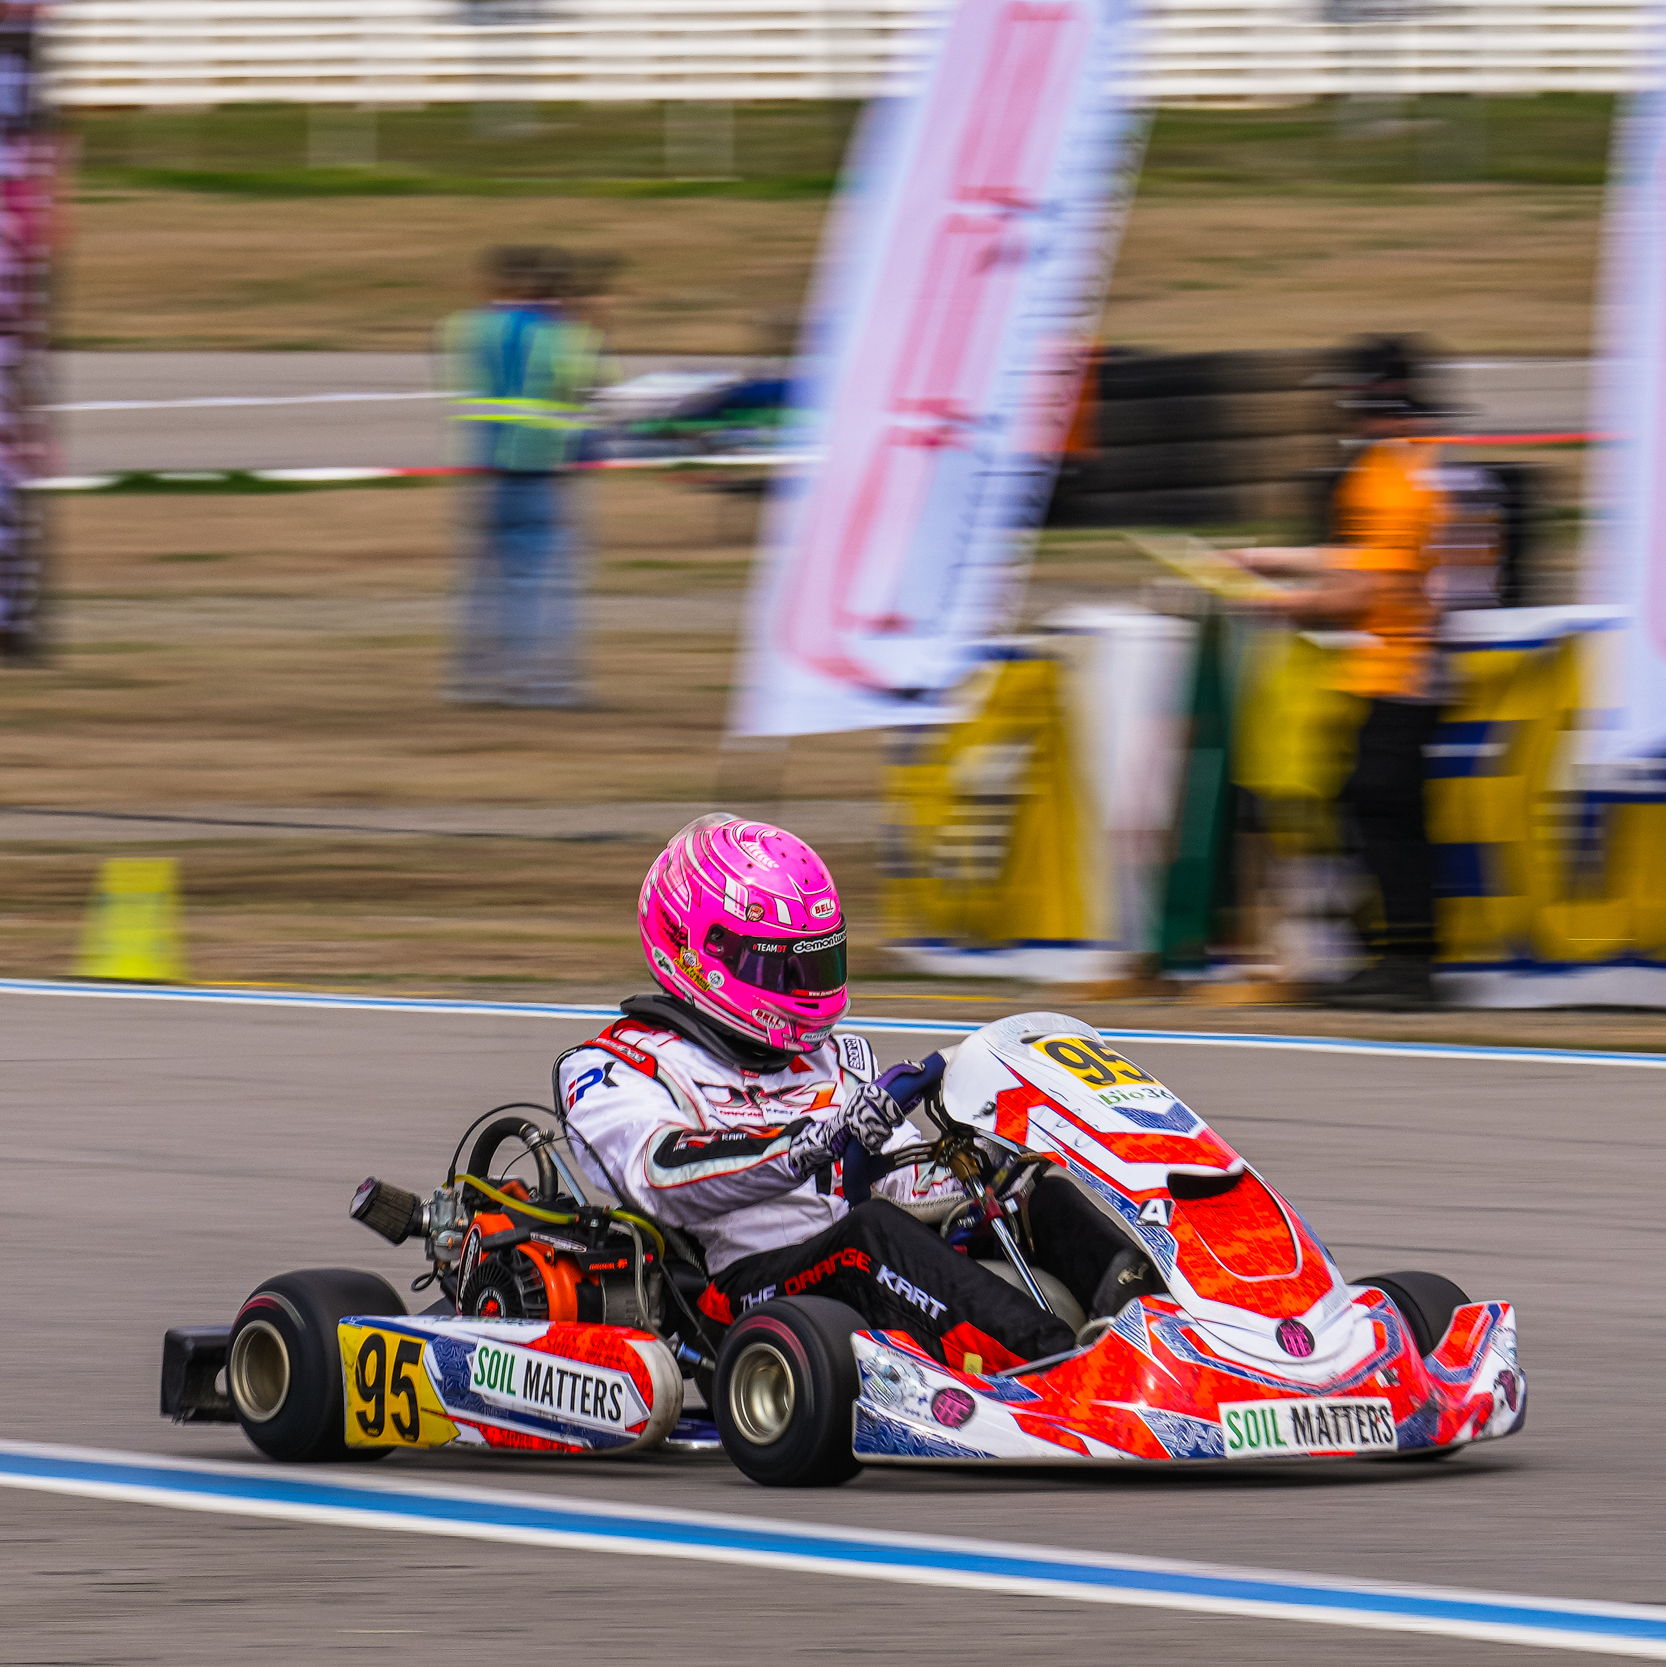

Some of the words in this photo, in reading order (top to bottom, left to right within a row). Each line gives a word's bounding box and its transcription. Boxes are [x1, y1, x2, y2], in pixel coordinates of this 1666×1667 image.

[815, 899, 834, 914] BELL
[756, 1009, 780, 1026] BELL
[1045, 1037, 1156, 1086] 95
[1139, 1200, 1169, 1225] A
[784, 1248, 871, 1296] ORANGE
[875, 1264, 948, 1320] KART
[355, 1333, 423, 1443] 95
[473, 1345, 517, 1396] SOIL
[522, 1357, 622, 1422] MATTERS
[1226, 1404, 1288, 1449] SOIL
[1290, 1403, 1394, 1446] MATTERS
